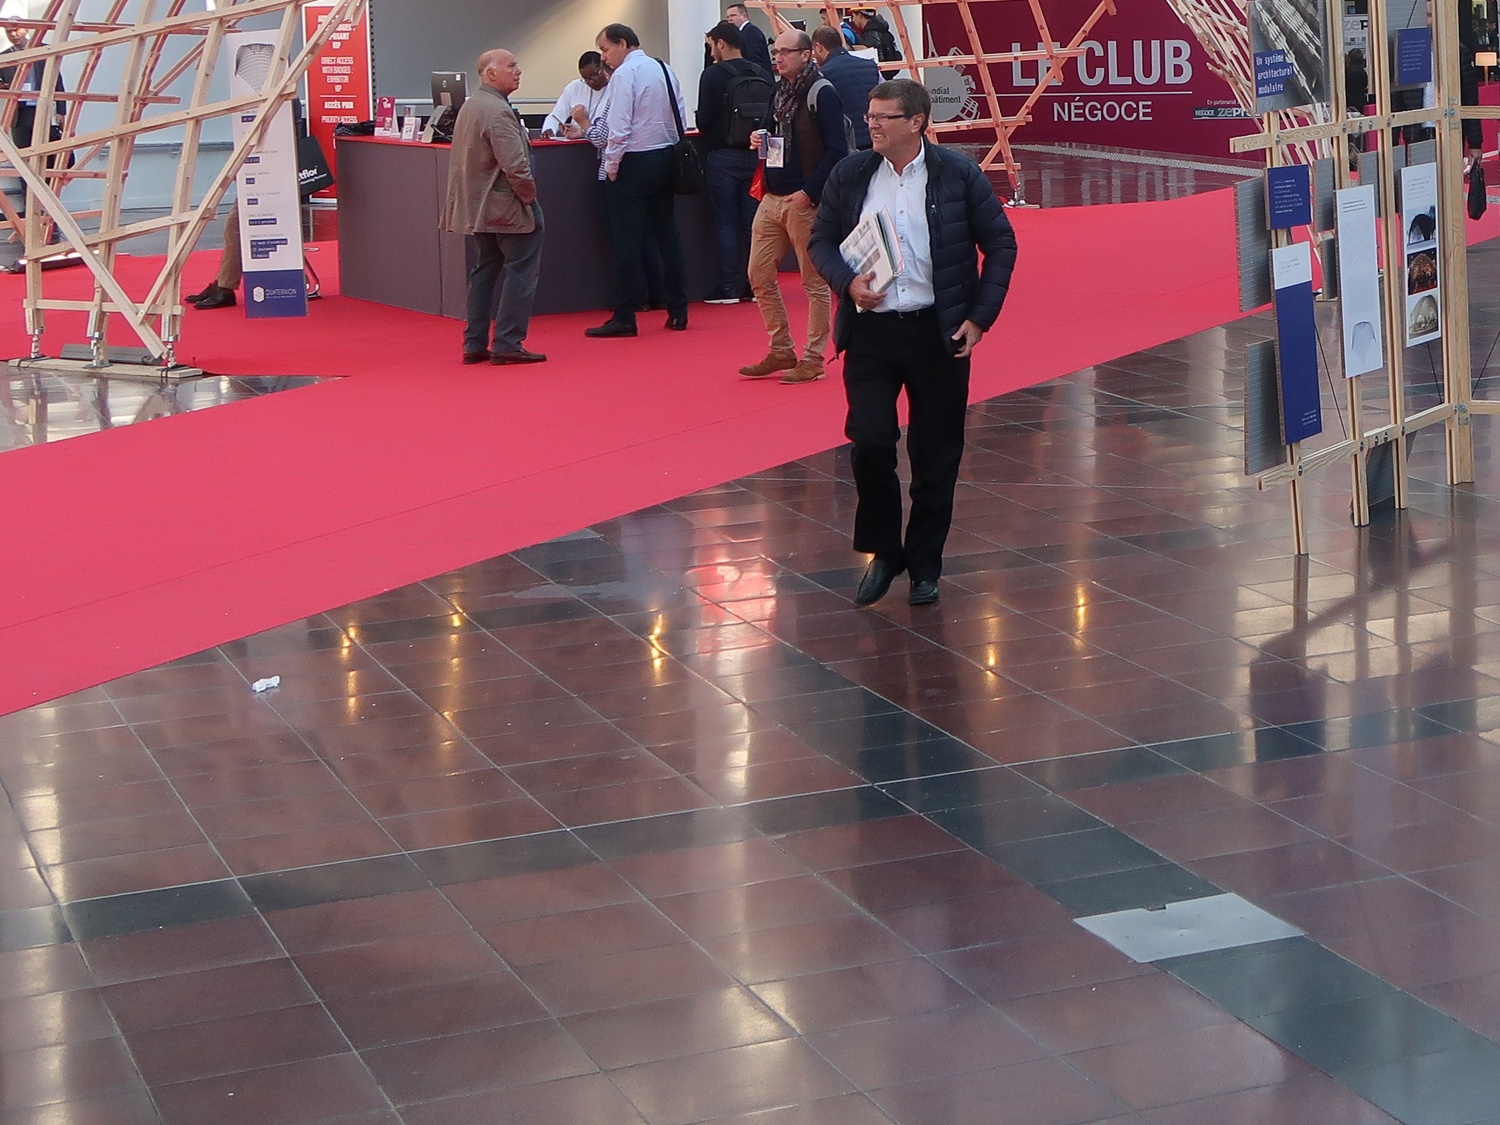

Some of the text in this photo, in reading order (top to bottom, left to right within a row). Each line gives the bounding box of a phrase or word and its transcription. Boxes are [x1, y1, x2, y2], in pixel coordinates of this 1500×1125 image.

[1081, 39, 1192, 87] CLUB
[1255, 53, 1284, 66] Un système
[1257, 66, 1293, 80] architectural
[1258, 84, 1284, 94] modulaire
[1053, 97, 1153, 122] NÉGOCE
